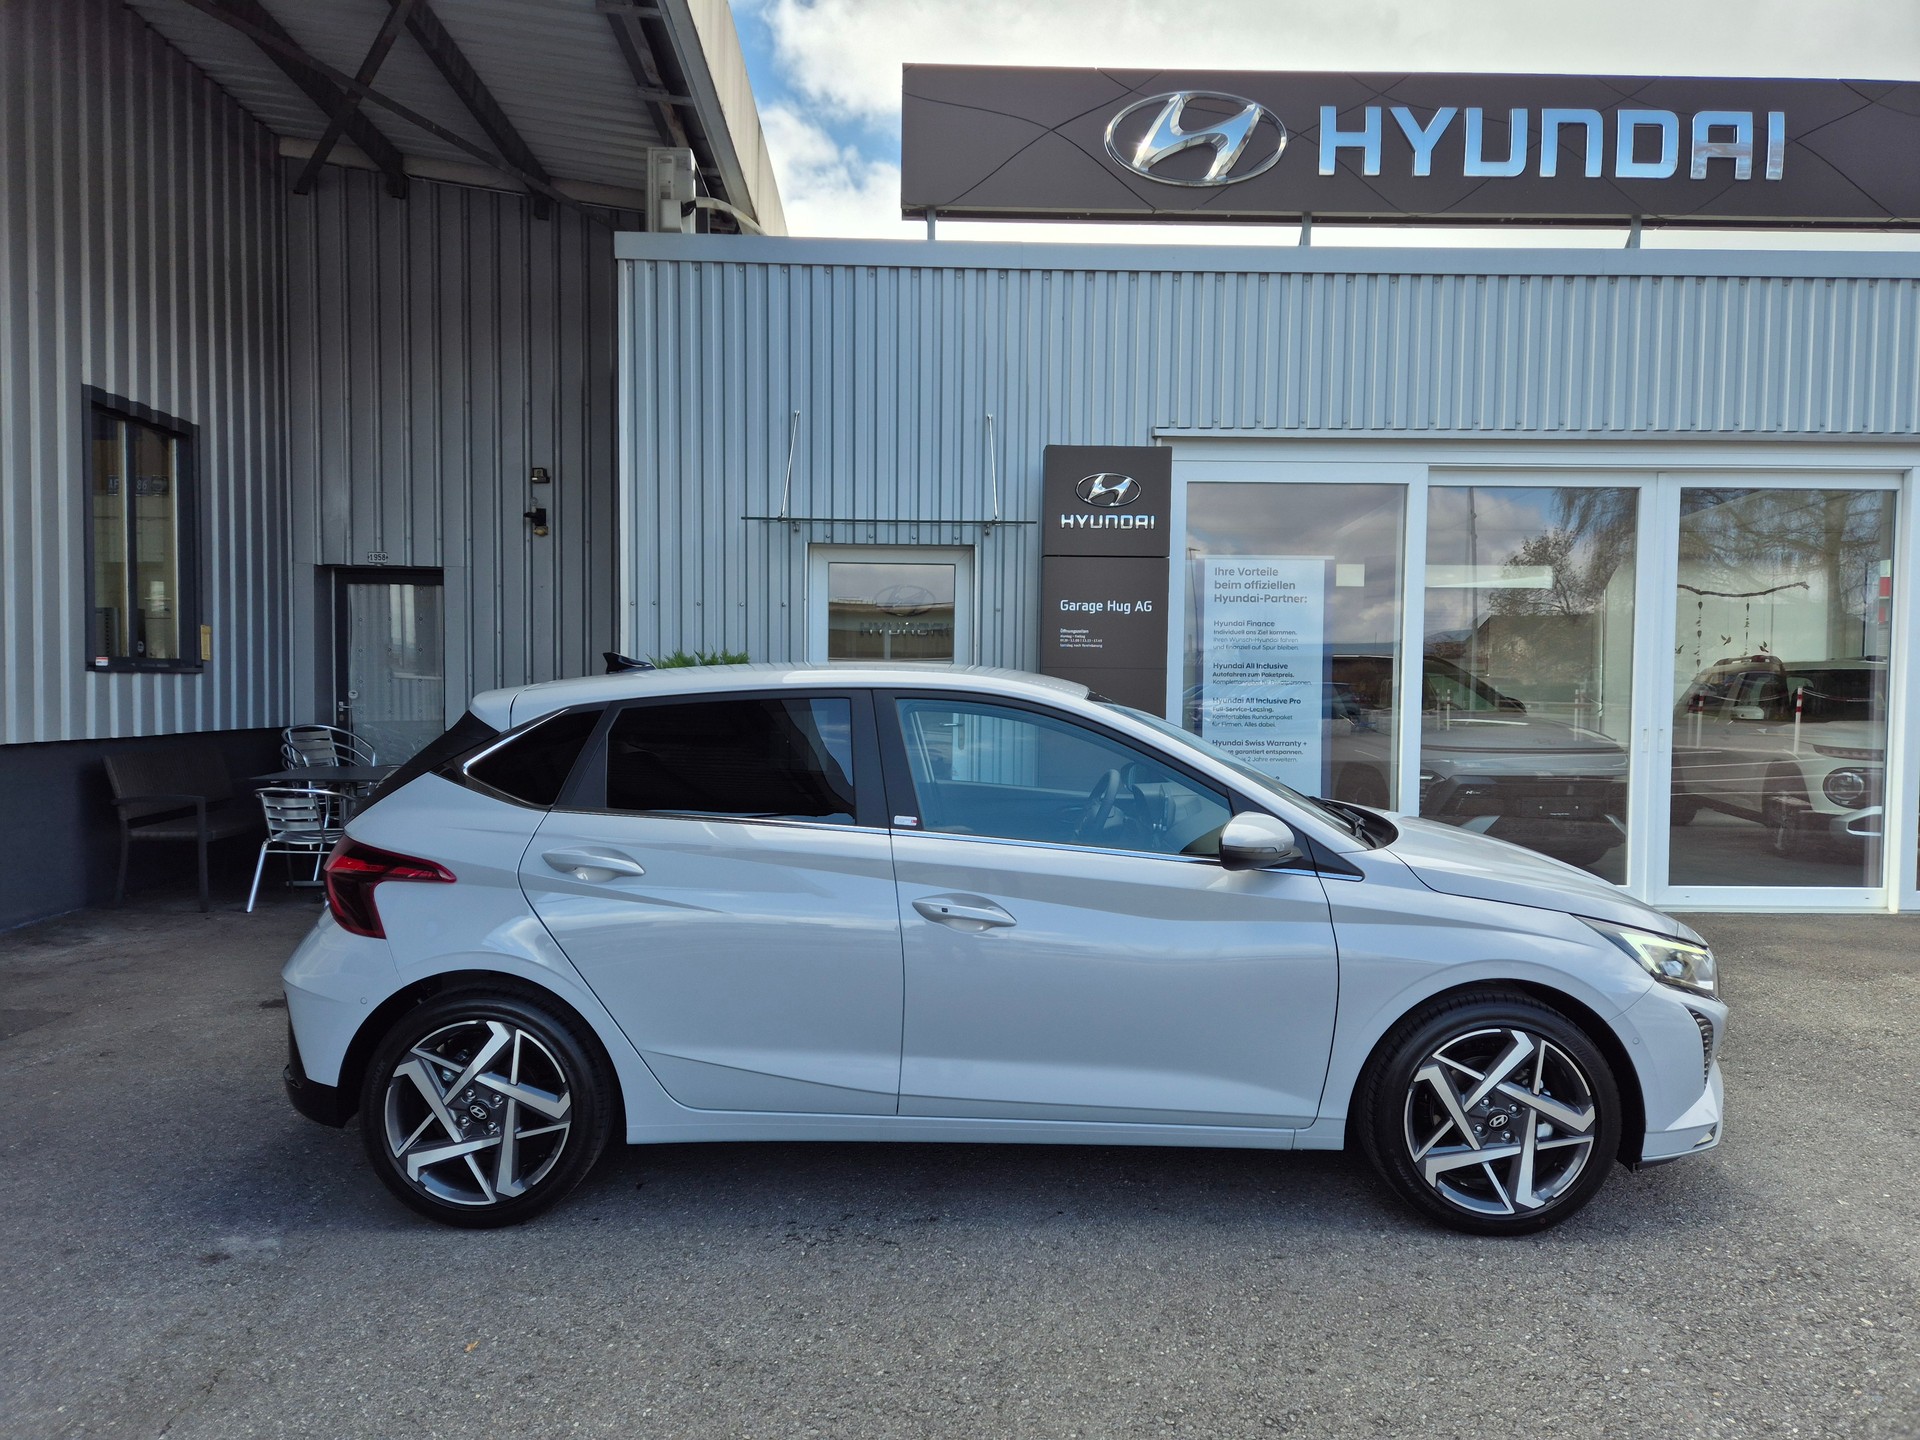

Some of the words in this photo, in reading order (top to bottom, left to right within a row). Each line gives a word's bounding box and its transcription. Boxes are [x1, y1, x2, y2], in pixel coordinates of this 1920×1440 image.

[1318, 105, 1785, 181] HYUNDAI
[1061, 514, 1155, 530] HYUNDAI
[369, 553, 386, 561] 1958
[1214, 567, 1235, 577] Ihre
[1237, 567, 1279, 577] Vorteile
[1214, 580, 1242, 590] beim
[1243, 580, 1296, 590] offiziellen
[1213, 593, 1308, 604] Hyundai-Partner:
[1060, 600, 1103, 614] Garage
[1107, 600, 1131, 615] Hug
[1134, 600, 1153, 612] AG
[1213, 620, 1245, 628] Hyundai
[1246, 620, 1276, 628] Finance
[1213, 662, 1245, 670] Hyundai
[1212, 697, 1245, 705] Hyundai
[1212, 739, 1244, 747] Hyundai
[1266, 739, 1302, 747] Warranty
